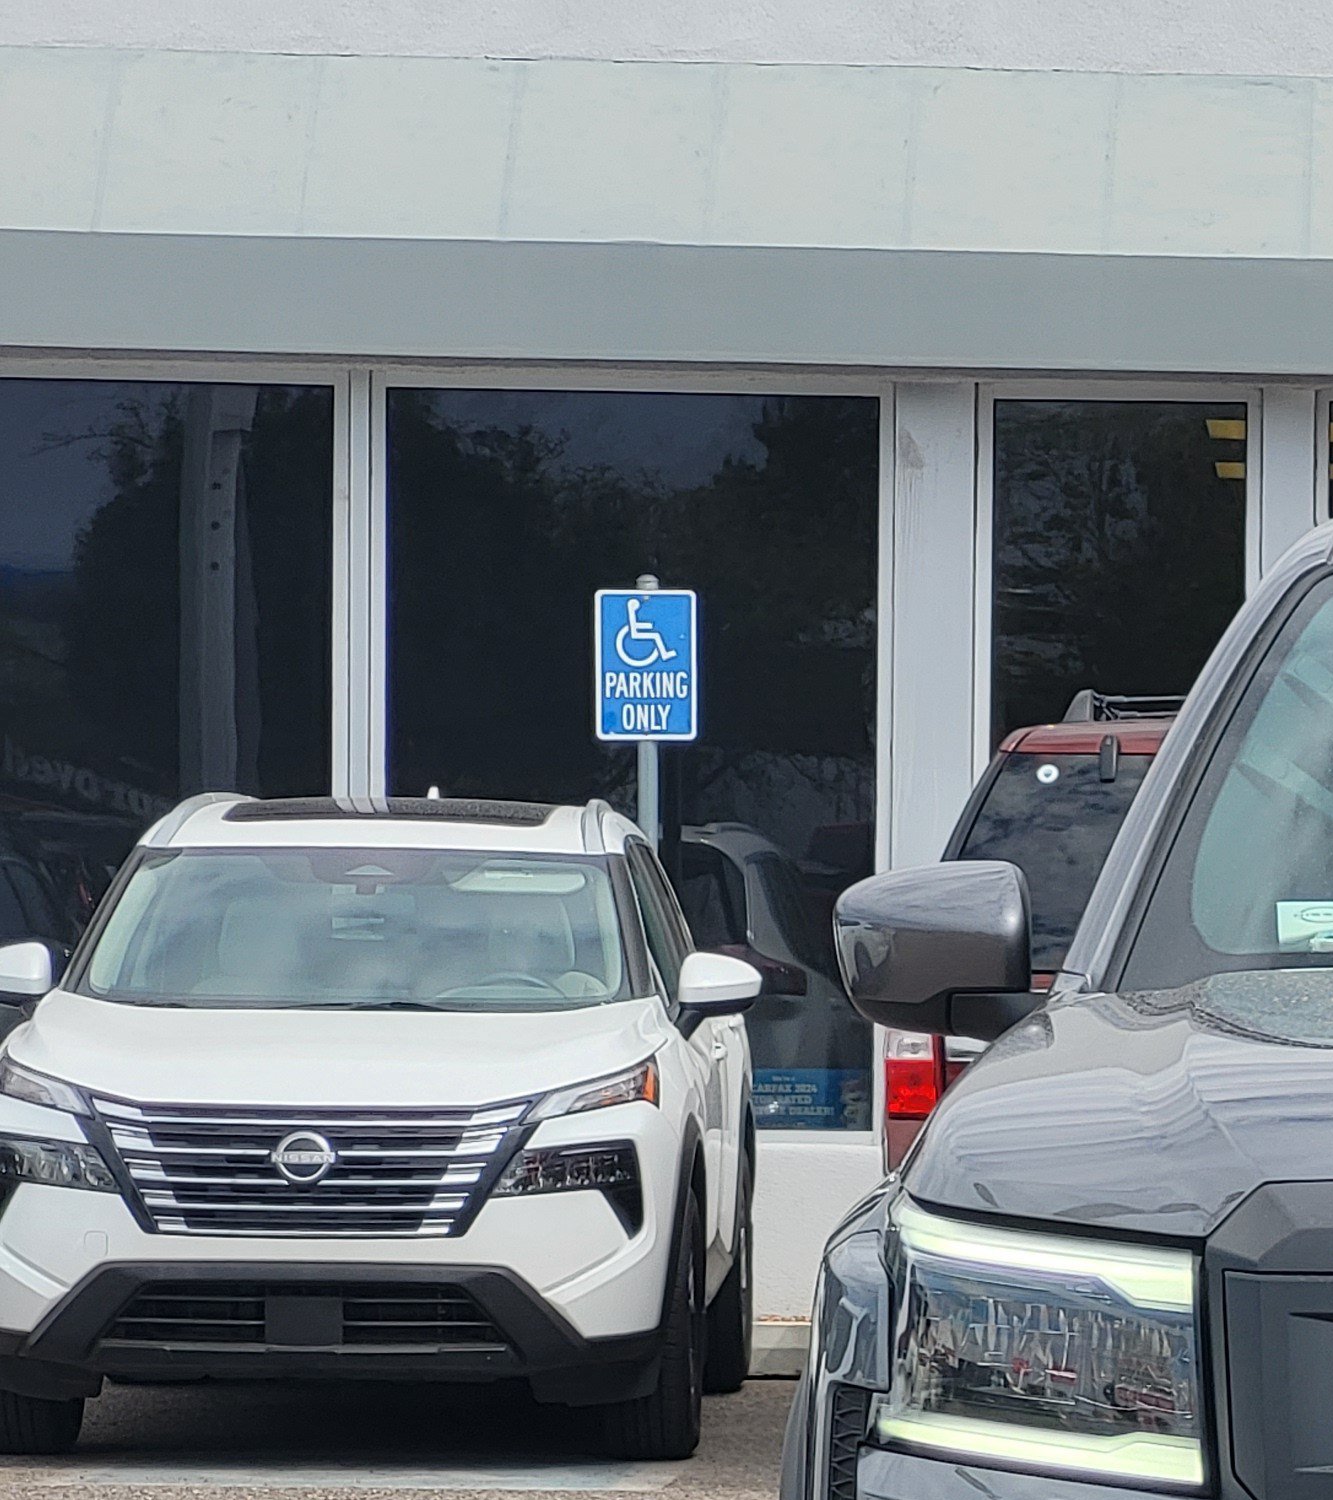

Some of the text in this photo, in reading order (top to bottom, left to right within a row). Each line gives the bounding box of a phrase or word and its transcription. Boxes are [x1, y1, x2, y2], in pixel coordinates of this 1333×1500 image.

[605, 671, 688, 699] PARKING
[622, 703, 671, 731] ONLY
[271, 1152, 336, 1163] NISSAN
